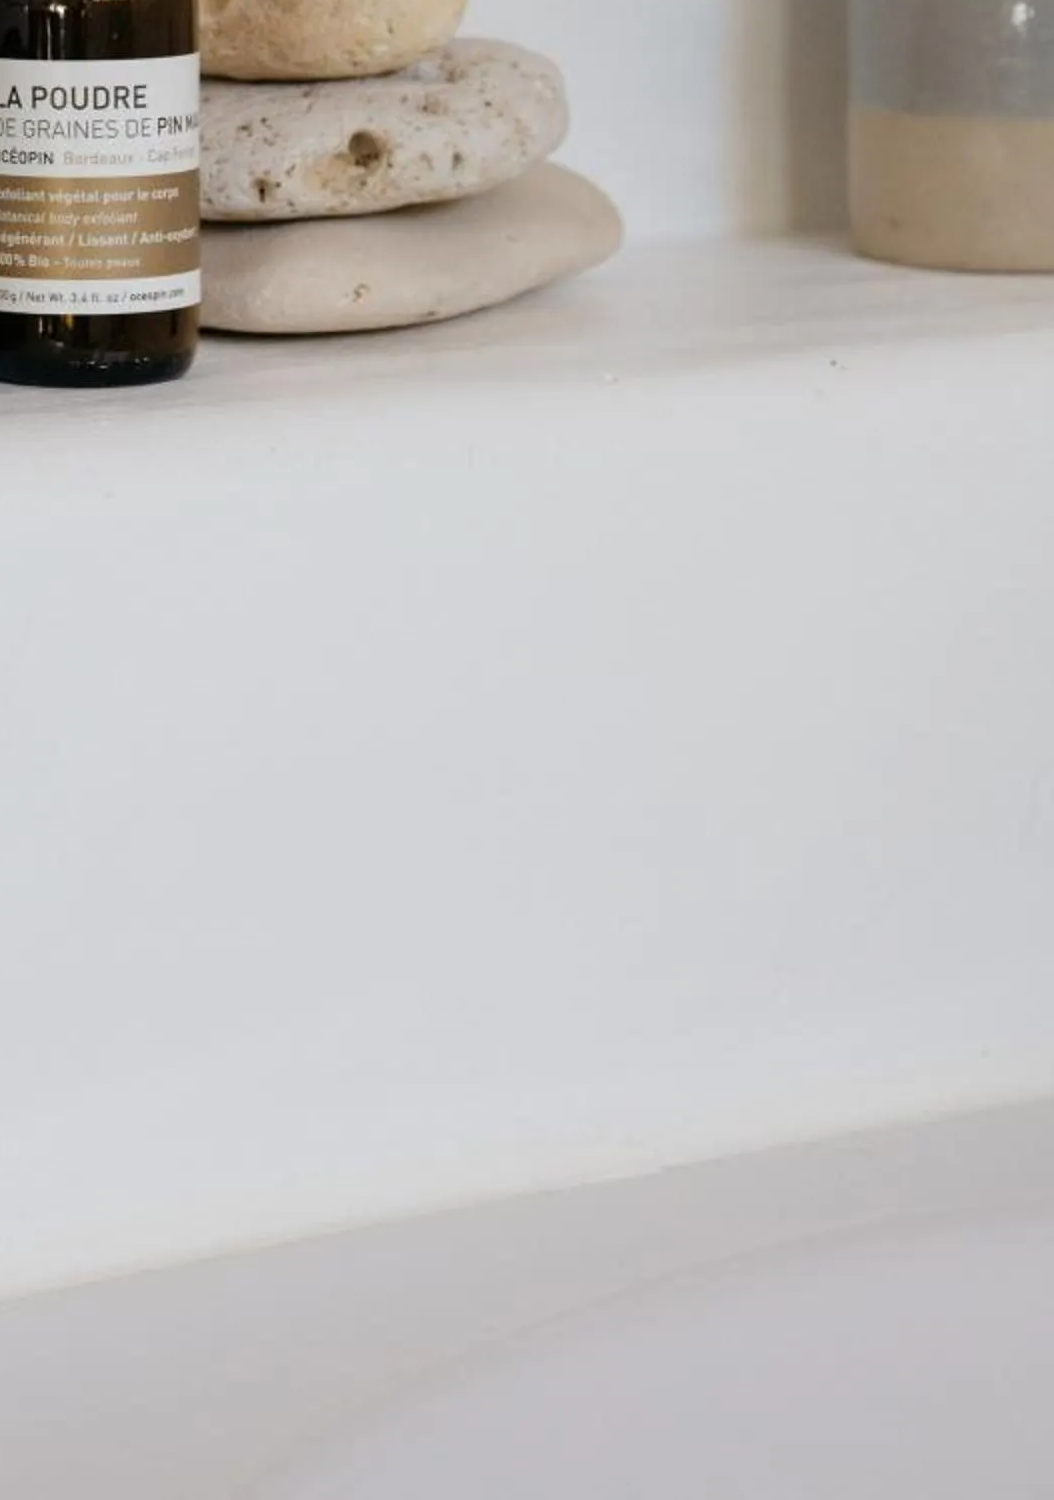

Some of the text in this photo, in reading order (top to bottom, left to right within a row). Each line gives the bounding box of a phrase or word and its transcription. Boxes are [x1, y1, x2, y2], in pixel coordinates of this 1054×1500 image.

[31, 84, 147, 110] POUDRE
[22, 117, 119, 139] GRAINES
[125, 117, 151, 139] DE
[157, 116, 183, 137] PIN
[63, 150, 133, 165] Bordeaux
[48, 188, 98, 205] végétal
[103, 190, 133, 205] pour
[137, 187, 150, 200] le
[151, 186, 180, 201] corps
[49, 210, 79, 226] body
[83, 211, 138, 226] exfoliant
[78, 232, 129, 247] Lissant
[28, 254, 50, 268] Bio
[26, 291, 45, 303] Net
